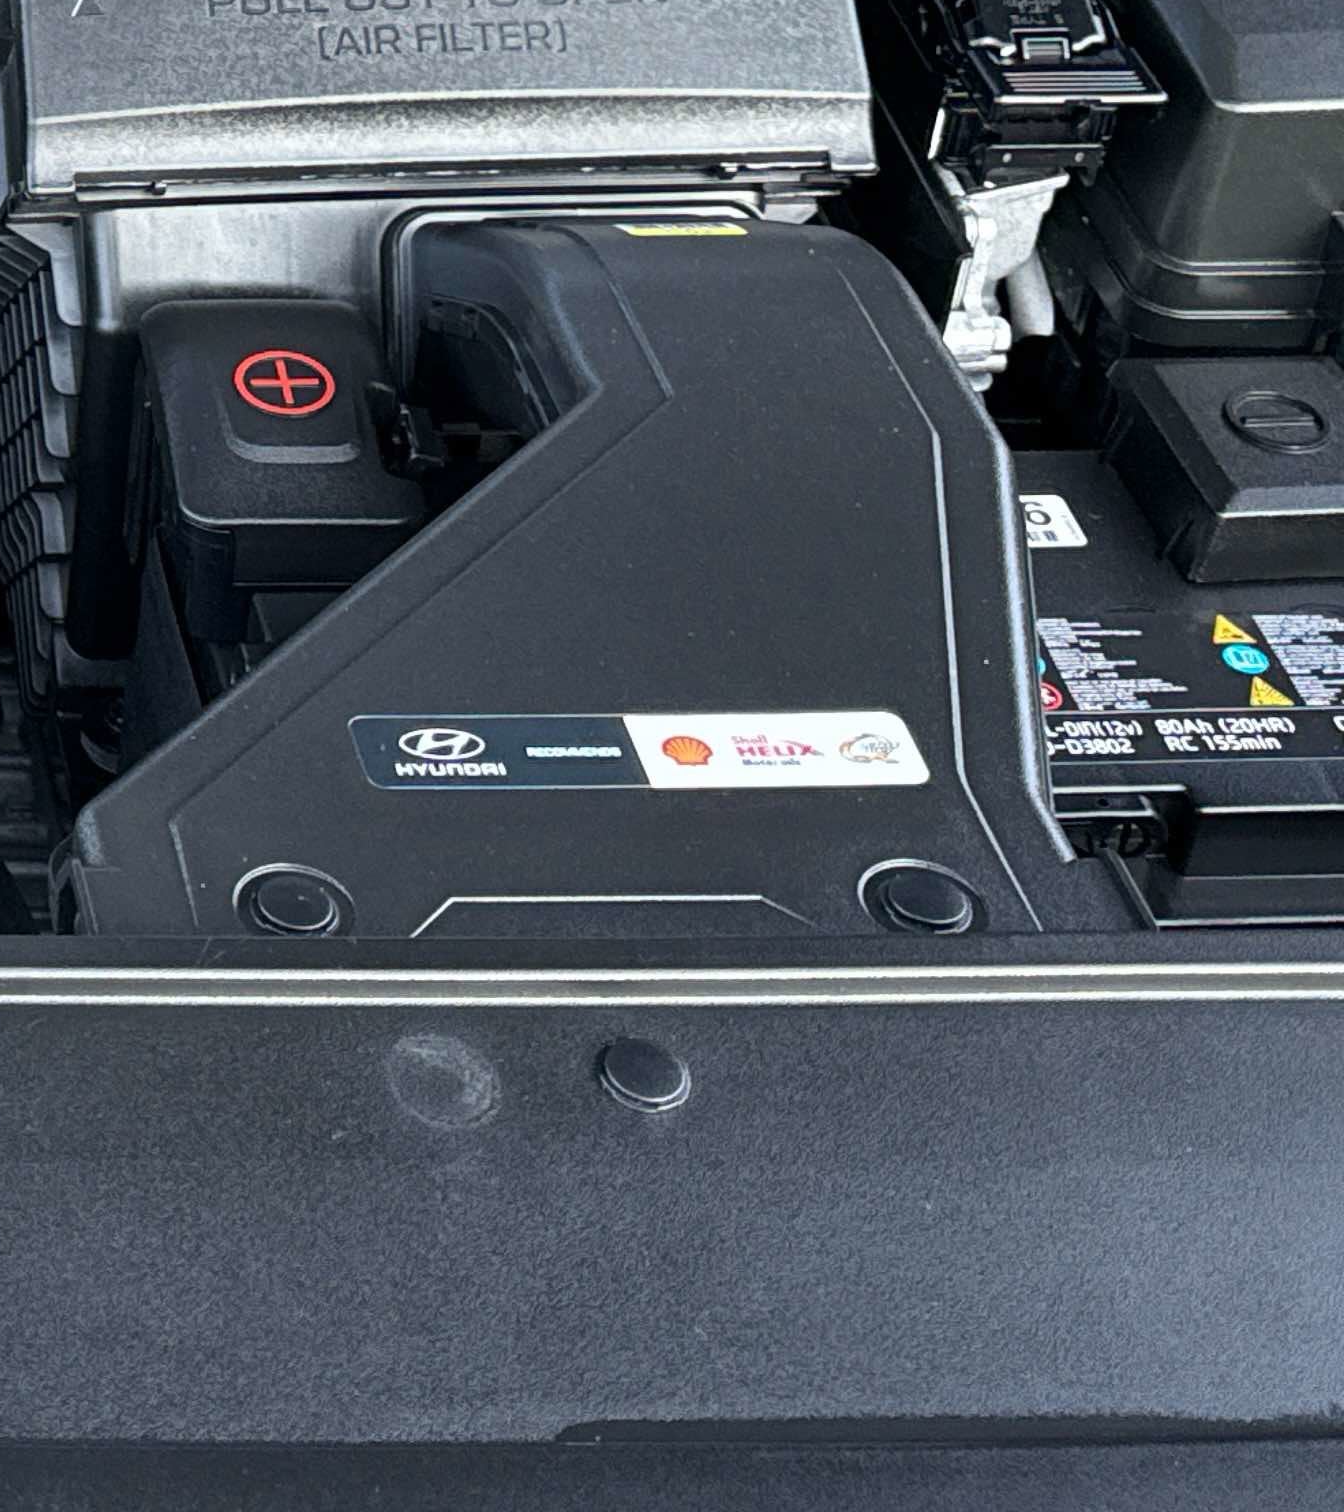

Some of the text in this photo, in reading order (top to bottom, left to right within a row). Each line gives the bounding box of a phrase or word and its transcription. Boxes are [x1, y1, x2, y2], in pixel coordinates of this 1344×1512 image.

[1153, 718, 1215, 736] 80Ah
[1218, 716, 1296, 735] (20HR)
[735, 744, 815, 757] HELIX
[1164, 734, 1200, 753] RC
[1201, 733, 1283, 752] 155min
[395, 761, 507, 777] HYUNDAI
